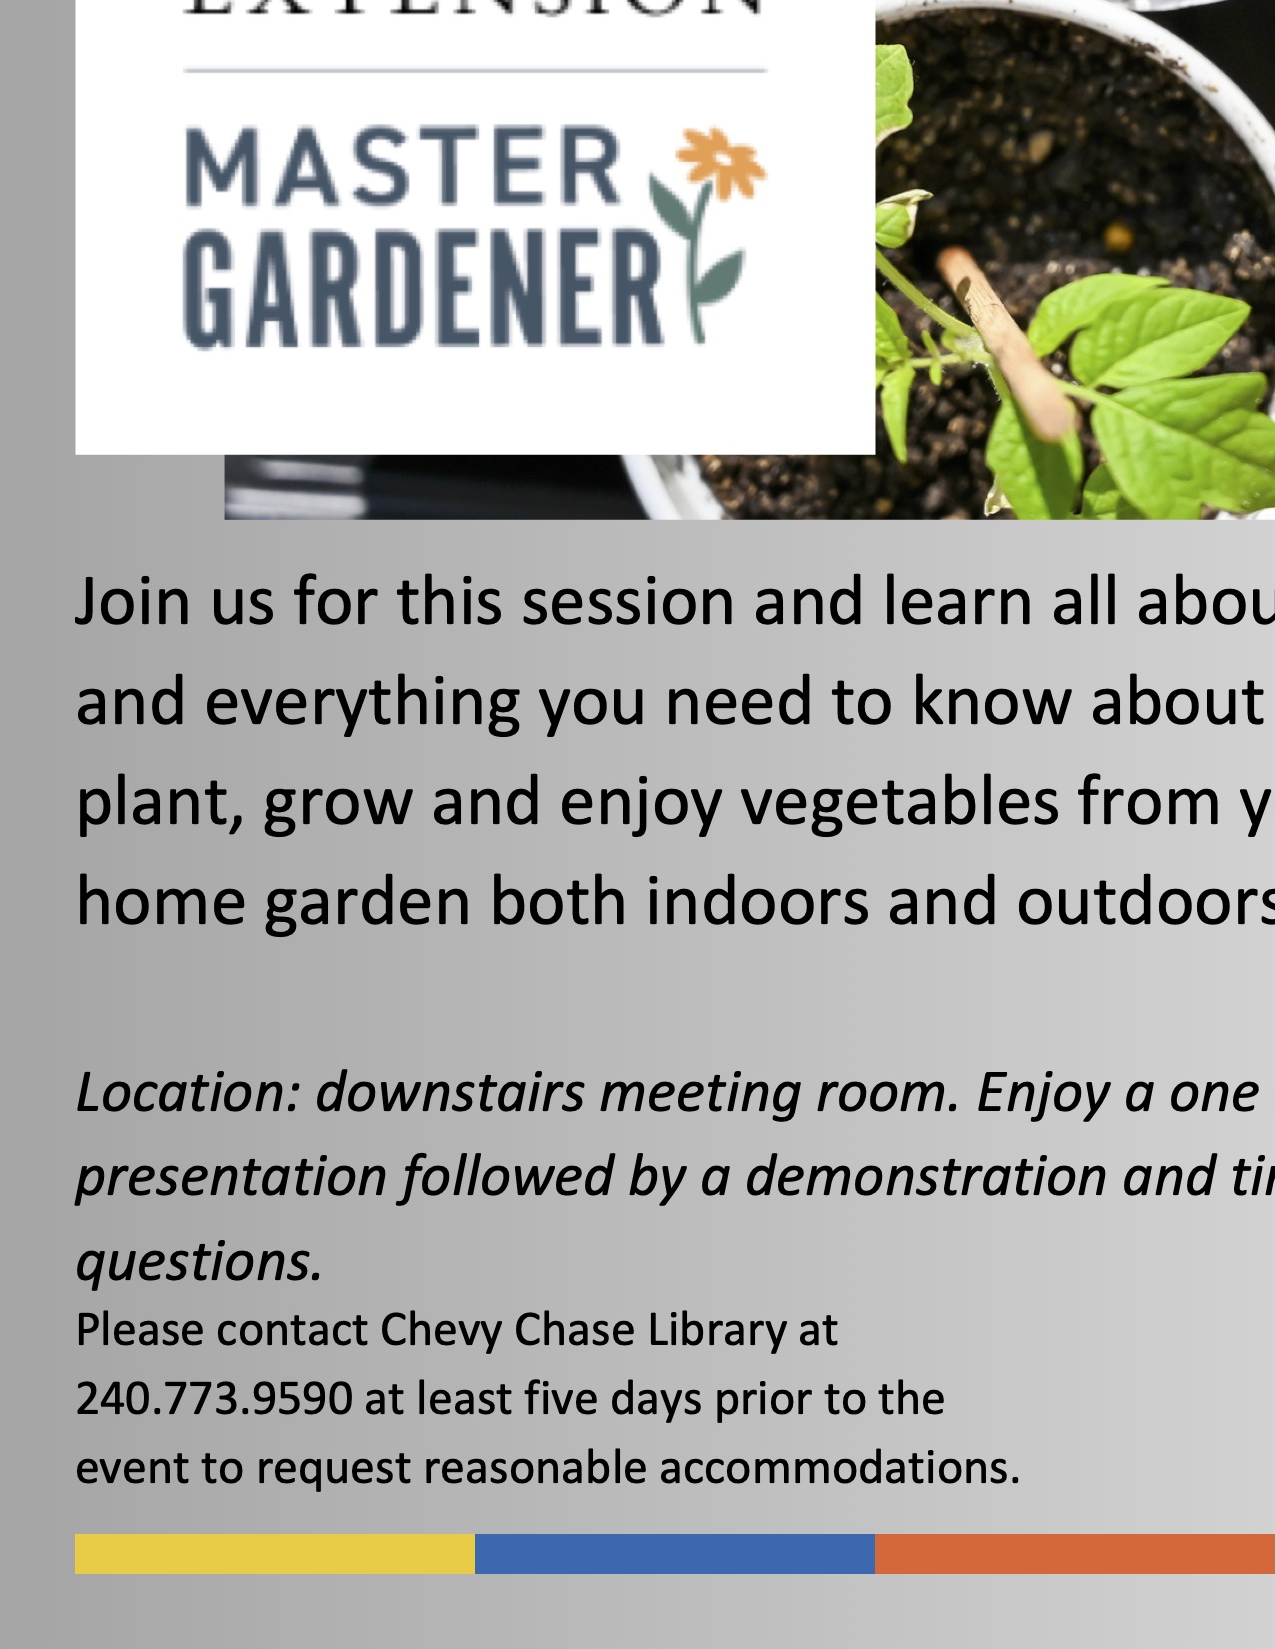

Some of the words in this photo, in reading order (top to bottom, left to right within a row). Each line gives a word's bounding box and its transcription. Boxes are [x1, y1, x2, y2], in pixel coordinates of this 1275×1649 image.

[186, 125, 620, 206] MASTER
[183, 228, 663, 350] GARDENER
[75, 576, 188, 625] Join
[214, 589, 273, 625] us
[294, 573, 378, 625] for
[397, 573, 501, 625] this
[523, 576, 732, 625] session
[756, 574, 861, 625] and
[887, 573, 1030, 625] learn
[1054, 573, 1115, 625] all
[78, 674, 183, 725] and
[207, 673, 520, 737] everything
[539, 689, 643, 737] you
[669, 674, 810, 725] need
[832, 680, 891, 725] to
[916, 673, 1072, 725] know
[1093, 673, 1264, 725] about
[80, 773, 242, 837] plant,
[264, 789, 413, 837] grow
[434, 774, 538, 825] and
[562, 776, 722, 837] enjoy
[741, 773, 1058, 837] vegetables
[1078, 773, 1218, 825] from
[80, 873, 244, 925] home
[265, 874, 468, 937] garden
[494, 873, 624, 925] both
[649, 874, 868, 925] indoors
[890, 874, 995, 925] and
[77, 1071, 299, 1112] Location:
[317, 1069, 585, 1112] downstairs
[600, 1071, 801, 1122] meeting
[817, 1081, 956, 1112] room.
[978, 1071, 1111, 1122] Enjoy
[1126, 1081, 1154, 1112] a
[1171, 1081, 1259, 1112] one
[74, 1155, 385, 1206] presentation
[396, 1153, 615, 1206] followed
[629, 1153, 687, 1206] by
[702, 1165, 730, 1196] a
[747, 1153, 1105, 1196] demonstration
[1124, 1153, 1218, 1196] and
[77, 1240, 319, 1291] questions.
[79, 1310, 203, 1346] Please
[218, 1315, 368, 1346] contact
[382, 1310, 502, 1354] Chevy
[516, 1310, 634, 1346] Chase
[651, 1310, 787, 1354] Library
[800, 1315, 838, 1346] at
[77, 1381, 352, 1415] 240.773.9590
[366, 1384, 404, 1415] at
[419, 1379, 512, 1415] least
[524, 1379, 597, 1415] five
[612, 1379, 701, 1423] days
[717, 1381, 812, 1423] prior
[824, 1384, 866, 1415] to
[878, 1379, 944, 1415] the
[77, 1453, 189, 1484] event
[201, 1453, 243, 1484] to
[259, 1453, 411, 1492] request
[426, 1448, 646, 1484] reasonable
[661, 1448, 1018, 1484] accommodations.
